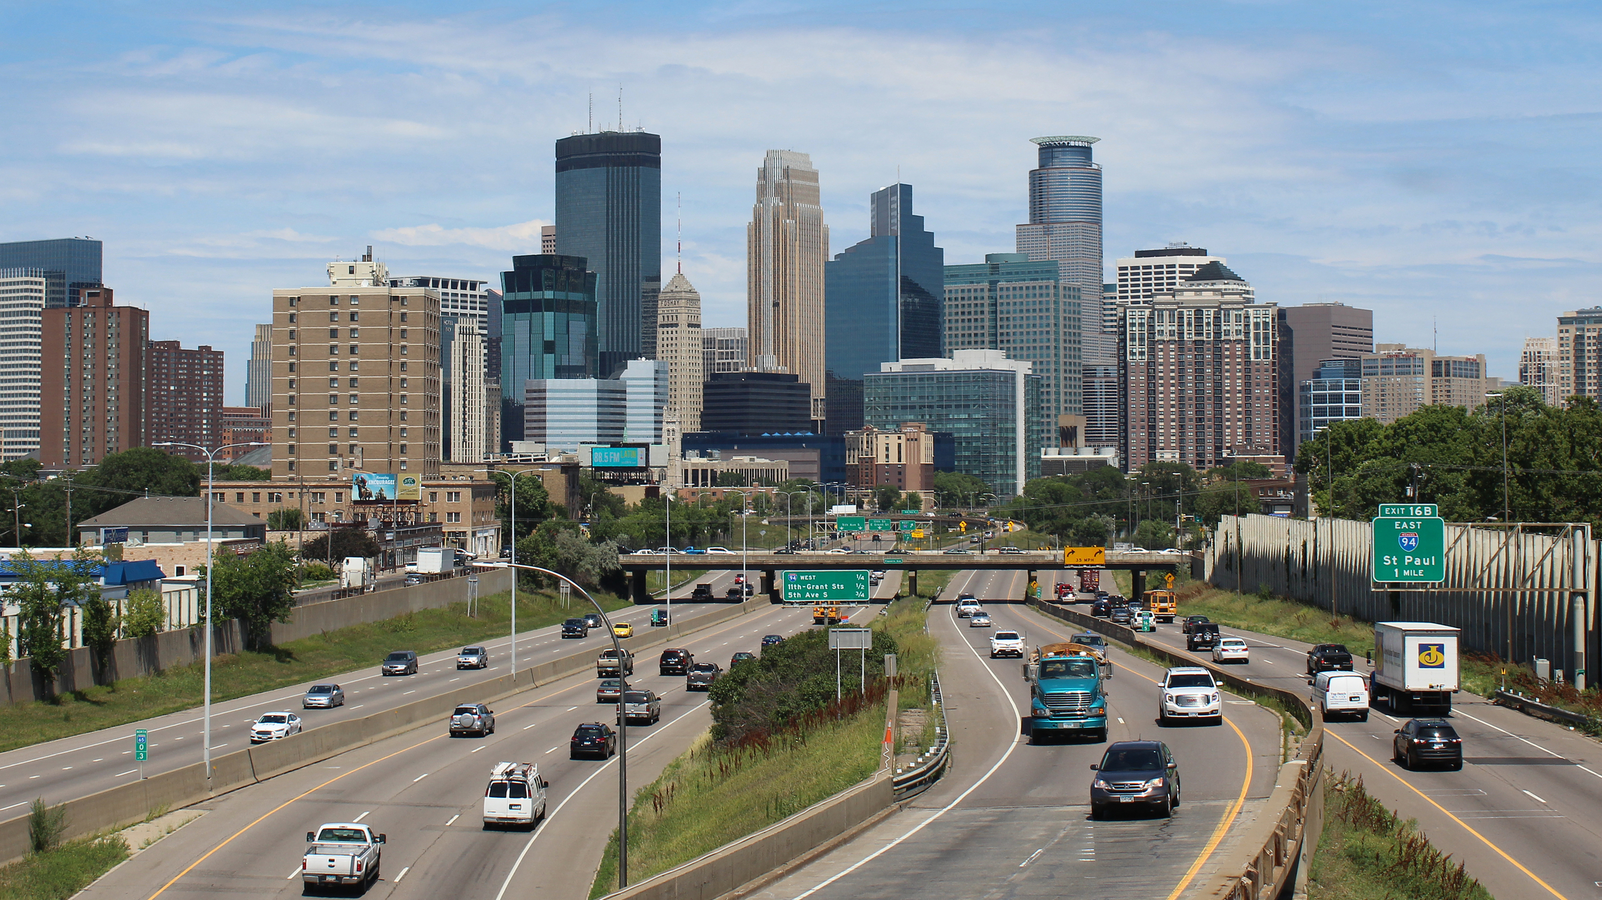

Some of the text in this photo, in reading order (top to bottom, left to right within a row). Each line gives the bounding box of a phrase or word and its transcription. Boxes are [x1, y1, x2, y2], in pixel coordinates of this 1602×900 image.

[594, 452, 620, 462] 88.5 FM
[620, 450, 636, 458] LATIN
[1410, 507, 1432, 516] 16B
[1402, 538, 1416, 547] 94
[1383, 555, 1435, 565] St Paul
[1394, 568, 1398, 577] 1
